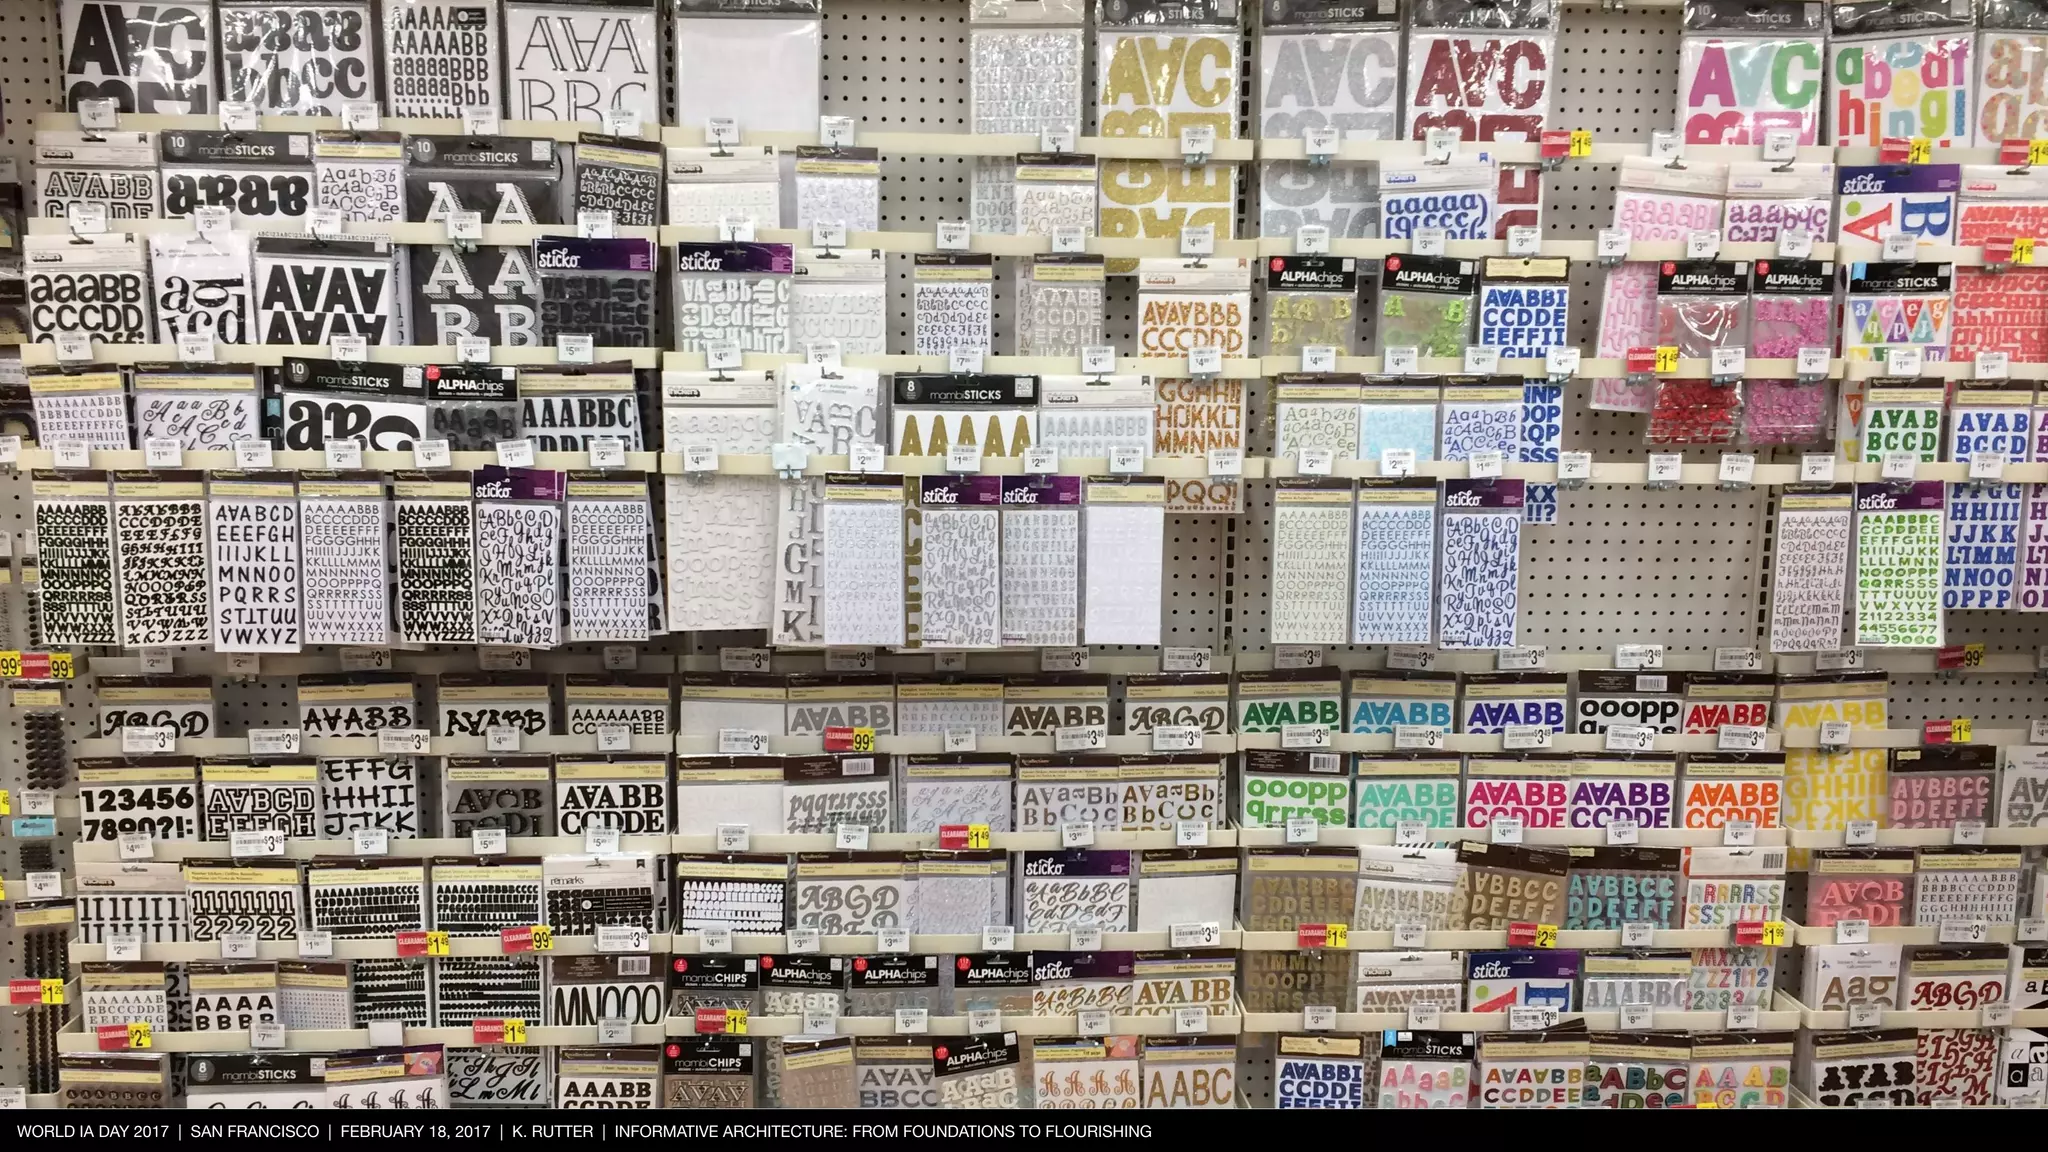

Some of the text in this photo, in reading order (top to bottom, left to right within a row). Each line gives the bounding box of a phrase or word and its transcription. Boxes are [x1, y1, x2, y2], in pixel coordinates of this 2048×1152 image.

[171, 137, 184, 147] 10
[418, 142, 430, 152] 10
[199, 146, 274, 155] mambiSTICKS
[444, 152, 518, 162] mambiSTICKS
[1841, 175, 1886, 194] sticko
[539, 248, 580, 268] sticko
[680, 251, 724, 270] sticko
[1281, 272, 1342, 283] ALPHAchips
[1396, 271, 1460, 284] ALPHAchips
[1672, 275, 1736, 287] ALPHAchips
[1766, 274, 1822, 286] ALPHAchips
[1864, 278, 1937, 287] mambiSTICKS
[292, 363, 304, 374] 10
[318, 376, 389, 388] mambiSTICKS
[438, 380, 503, 392] ALPHAchips
[908, 381, 914, 391] 8
[931, 390, 1001, 399] mambiSTICKS
[522, 399, 632, 428] AAABBC
[476, 481, 512, 498] sticko
[922, 485, 959, 504] sticko
[1002, 485, 1038, 504] sticko
[1447, 490, 1482, 506] sticko
[1858, 492, 1898, 510] sticko
[217, 525, 294, 542] EEEFGH
[1949, 525, 2017, 543] JJKK
[219, 566, 294, 582] MNNOO
[1944, 566, 2014, 588] NNOO
[220, 586, 295, 604] PQRRS
[221, 628, 297, 644] VWXYZ
[1580, 700, 1679, 723] ooopp
[82, 787, 194, 812] 123456
[1024, 857, 1065, 875] sticko
[551, 876, 584, 885] remarks
[772, 968, 831, 981] ALPHAchips
[865, 969, 926, 980] ALPHAchips
[968, 968, 1028, 979] ALPHAchips
[1034, 959, 1072, 980] sticko
[1474, 961, 1510, 978] sticko
[682, 974, 746, 982] mambiCHIPS
[698, 1014, 725, 1022] CLEARANCE
[1393, 1045, 1462, 1055] mambiSTICKS
[675, 1058, 741, 1067] mambiCHIPS
[947, 1049, 1007, 1067] ALPHAchips
[199, 1062, 206, 1072] 8
[223, 1070, 296, 1079] mambiSTICKS
[564, 1082, 651, 1097] AAABB
[1147, 1068, 1231, 1108] AABC
